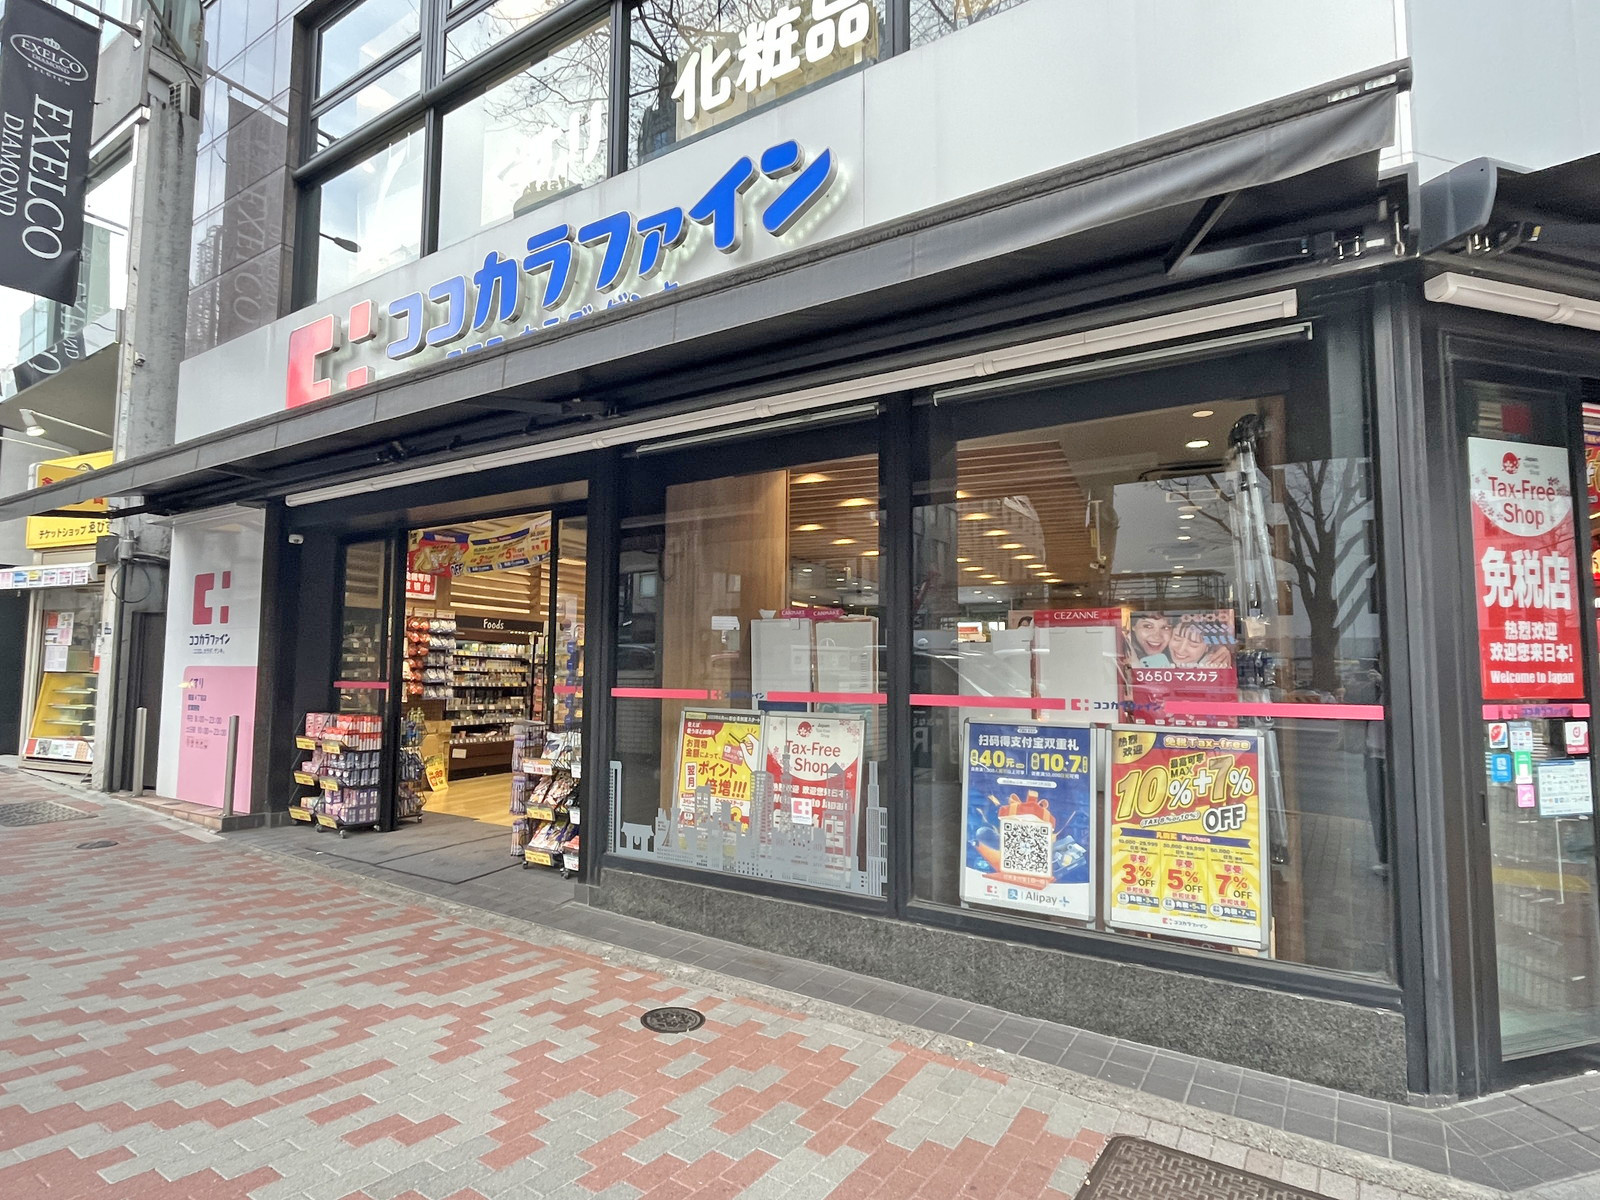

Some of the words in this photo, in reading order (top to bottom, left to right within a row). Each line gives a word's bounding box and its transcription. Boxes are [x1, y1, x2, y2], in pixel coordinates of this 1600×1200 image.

[21, 38, 82, 73] EXELCO
[31, 53, 70, 75] DIAMOND
[671, 0, 870, 121] 化粧品
[0, 111, 24, 217] DIAMOND
[21, 94, 74, 260] EXELCO
[386, 139, 838, 361] ココカラファイン
[1488, 476, 1556, 502] Tax-Free
[1503, 502, 1545, 530] Shop
[39, 526, 87, 540] チケットショップ
[1481, 546, 1572, 610] 免税店
[483, 618, 505, 630] Foods
[1053, 611, 1100, 621] CEZANNE
[189, 633, 231, 646] ココカラファイン
[1504, 620, 1558, 641] 热烈欢迎
[1489, 642, 1574, 663] 欢迎您来日本!
[1136, 670, 1218, 682] 3650マスカラ
[1489, 670, 1536, 684] Welcome
[1536, 671, 1547, 683] to
[1547, 670, 1575, 684] Japan
[786, 740, 841, 758] Tax-Free
[978, 734, 1080, 751] 扫码得支付宝双重礼
[1122, 744, 1143, 757] 欢迎
[698, 760, 738, 779] ポイント
[794, 757, 829, 776] Shop
[1170, 766, 1193, 778] MAX
[687, 765, 696, 788] 翌月
[1204, 806, 1244, 832] OFF
[1181, 834, 1212, 844] Purchase
[1121, 863, 1152, 885] 3%
[1138, 879, 1156, 888] OFF
[1167, 868, 1199, 891] 5%
[1184, 883, 1204, 893] OFF
[1215, 873, 1248, 896] 7%
[1025, 891, 1058, 906] Alipay
[1233, 889, 1253, 900] OFF
